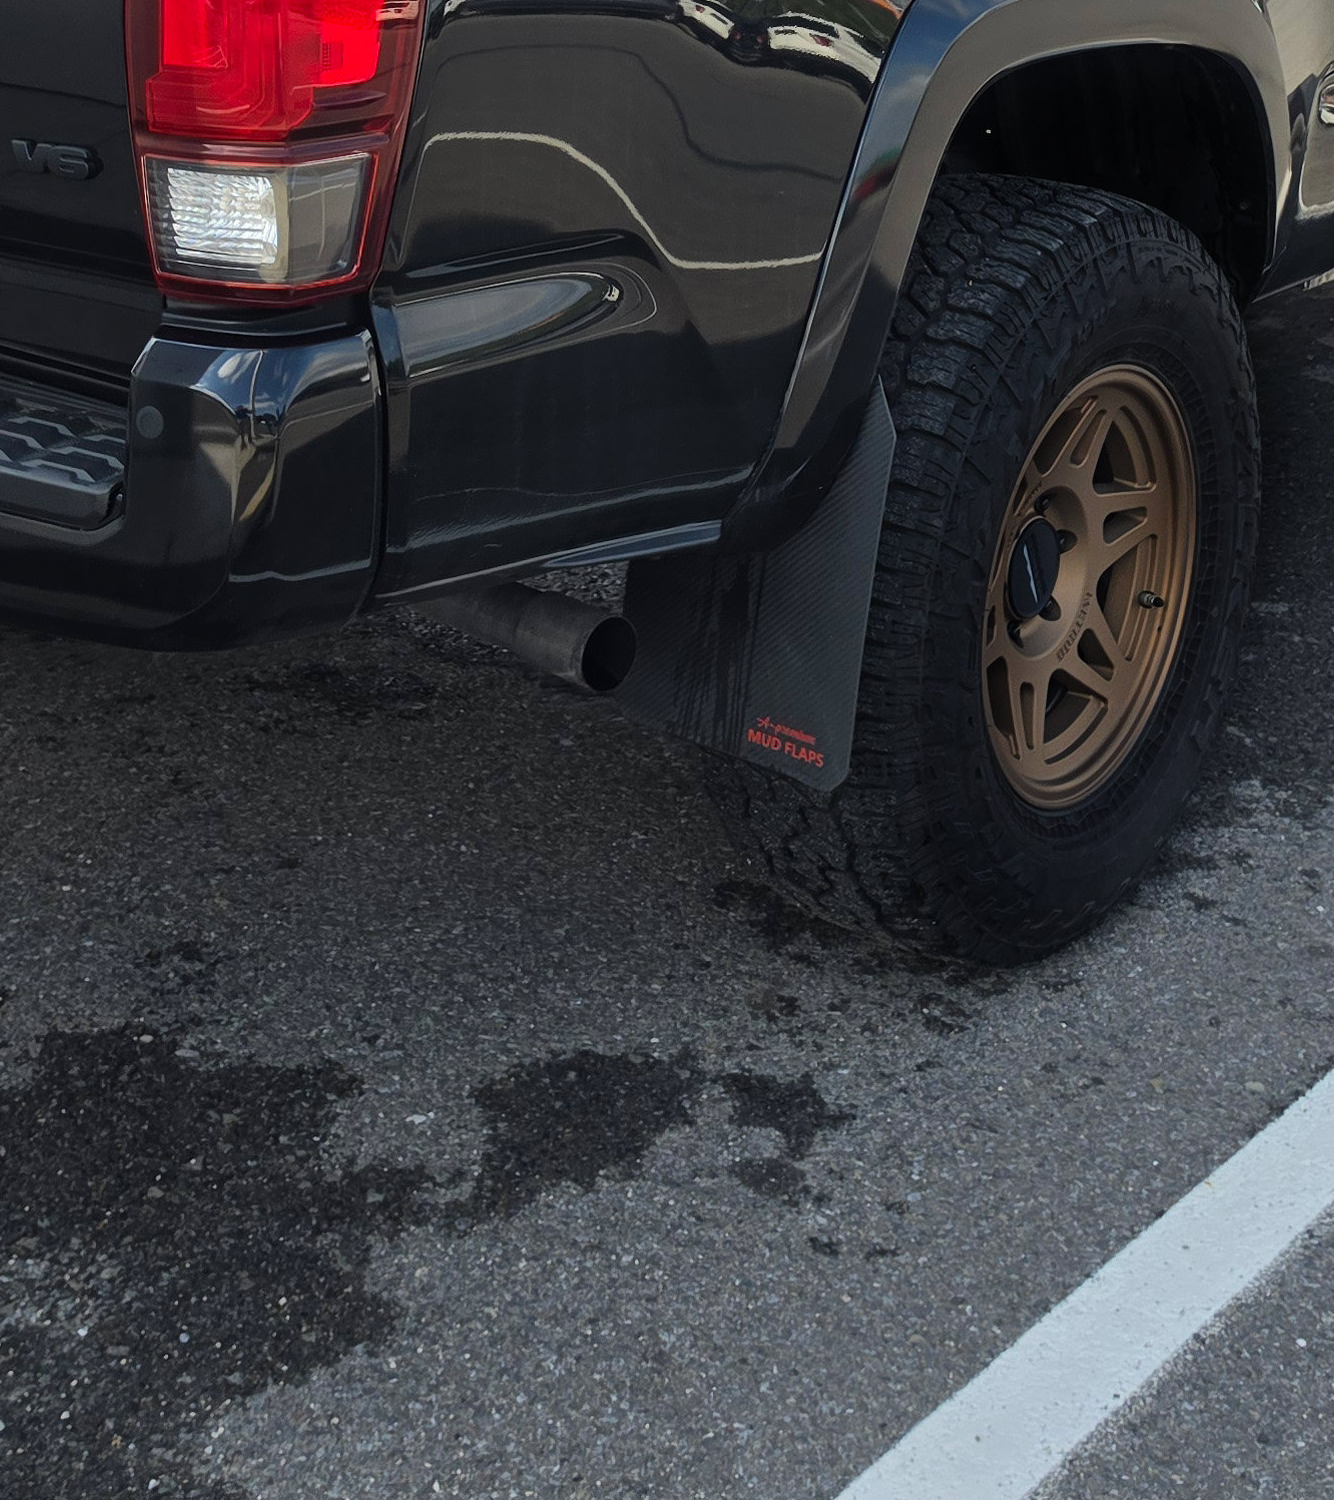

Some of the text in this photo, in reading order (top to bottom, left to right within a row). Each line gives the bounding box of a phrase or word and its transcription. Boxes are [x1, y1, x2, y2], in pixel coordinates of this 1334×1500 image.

[10, 138, 91, 180] V6
[748, 729, 824, 768] MUD FLAPS
